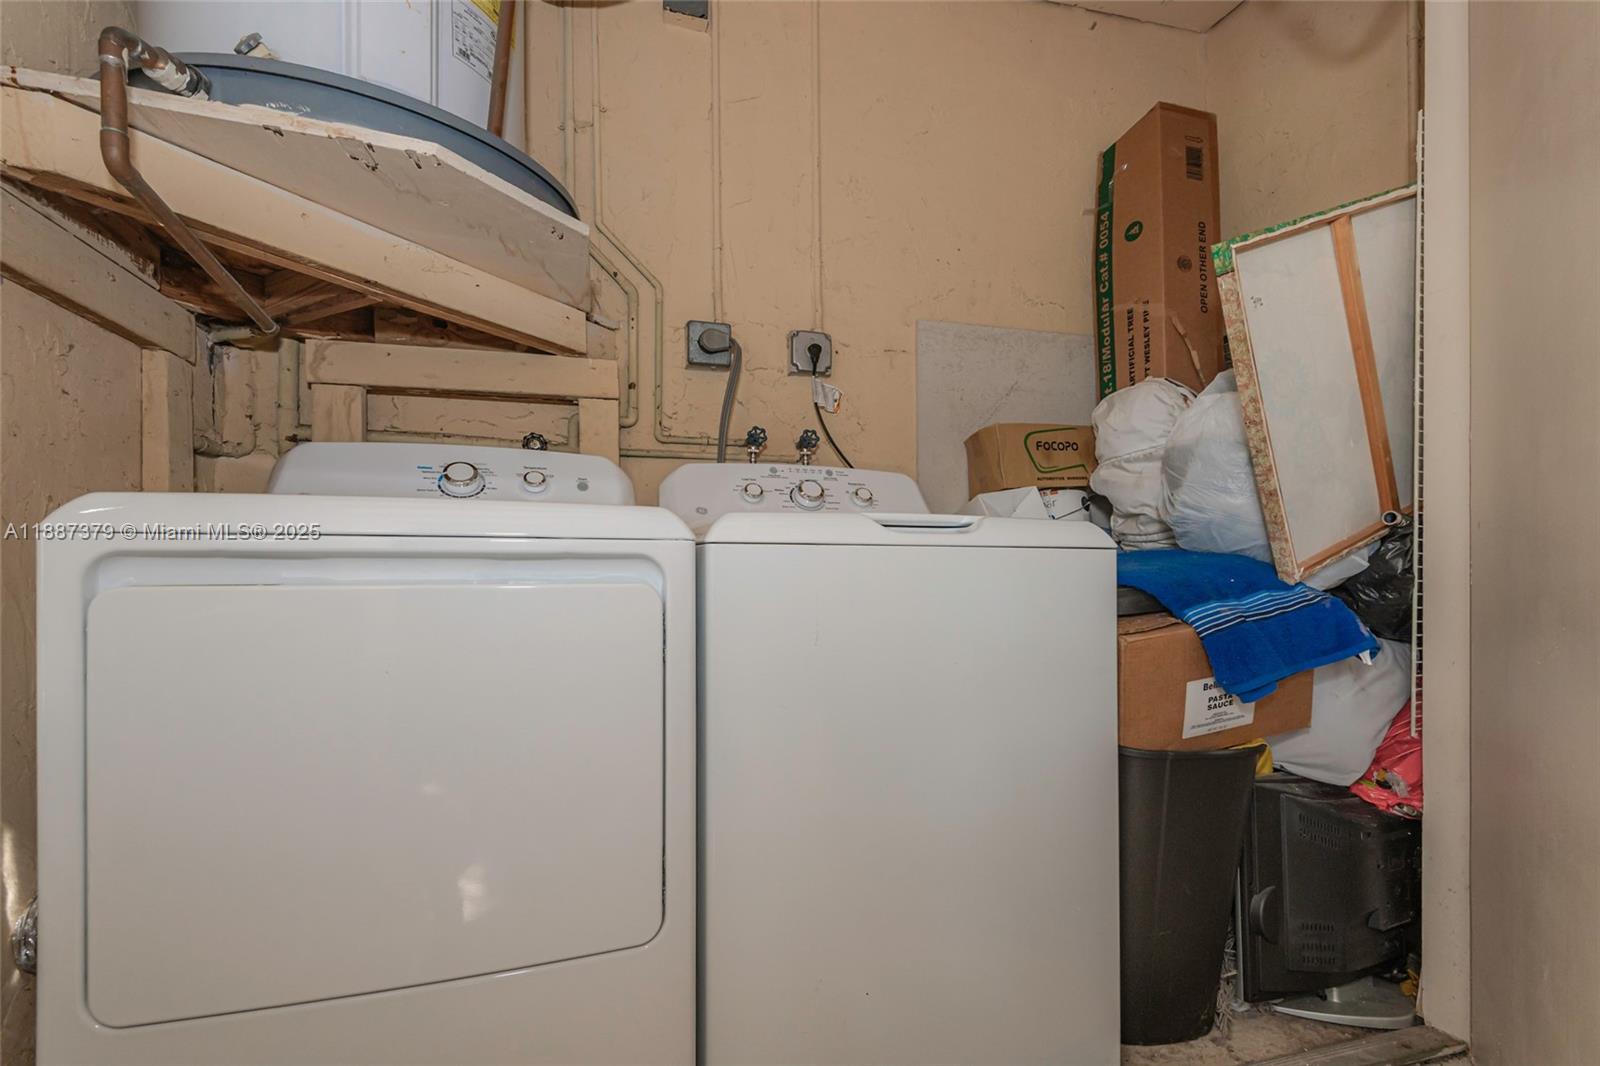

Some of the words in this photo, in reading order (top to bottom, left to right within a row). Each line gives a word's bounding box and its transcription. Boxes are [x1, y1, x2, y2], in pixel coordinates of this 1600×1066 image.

[1099, 211, 1110, 249] 0054
[1198, 221, 1206, 243] END
[1099, 252, 1110, 293] Cat.#
[1198, 246, 1208, 282] OTHER
[1199, 284, 1208, 314] OPEN
[1126, 307, 1134, 334] TREE
[1143, 326, 1151, 365] WESLEY
[1036, 440, 1079, 452] FOCOPO
[1207, 700, 1234, 710] SAUCE
[1208, 694, 1234, 704] PASTA
